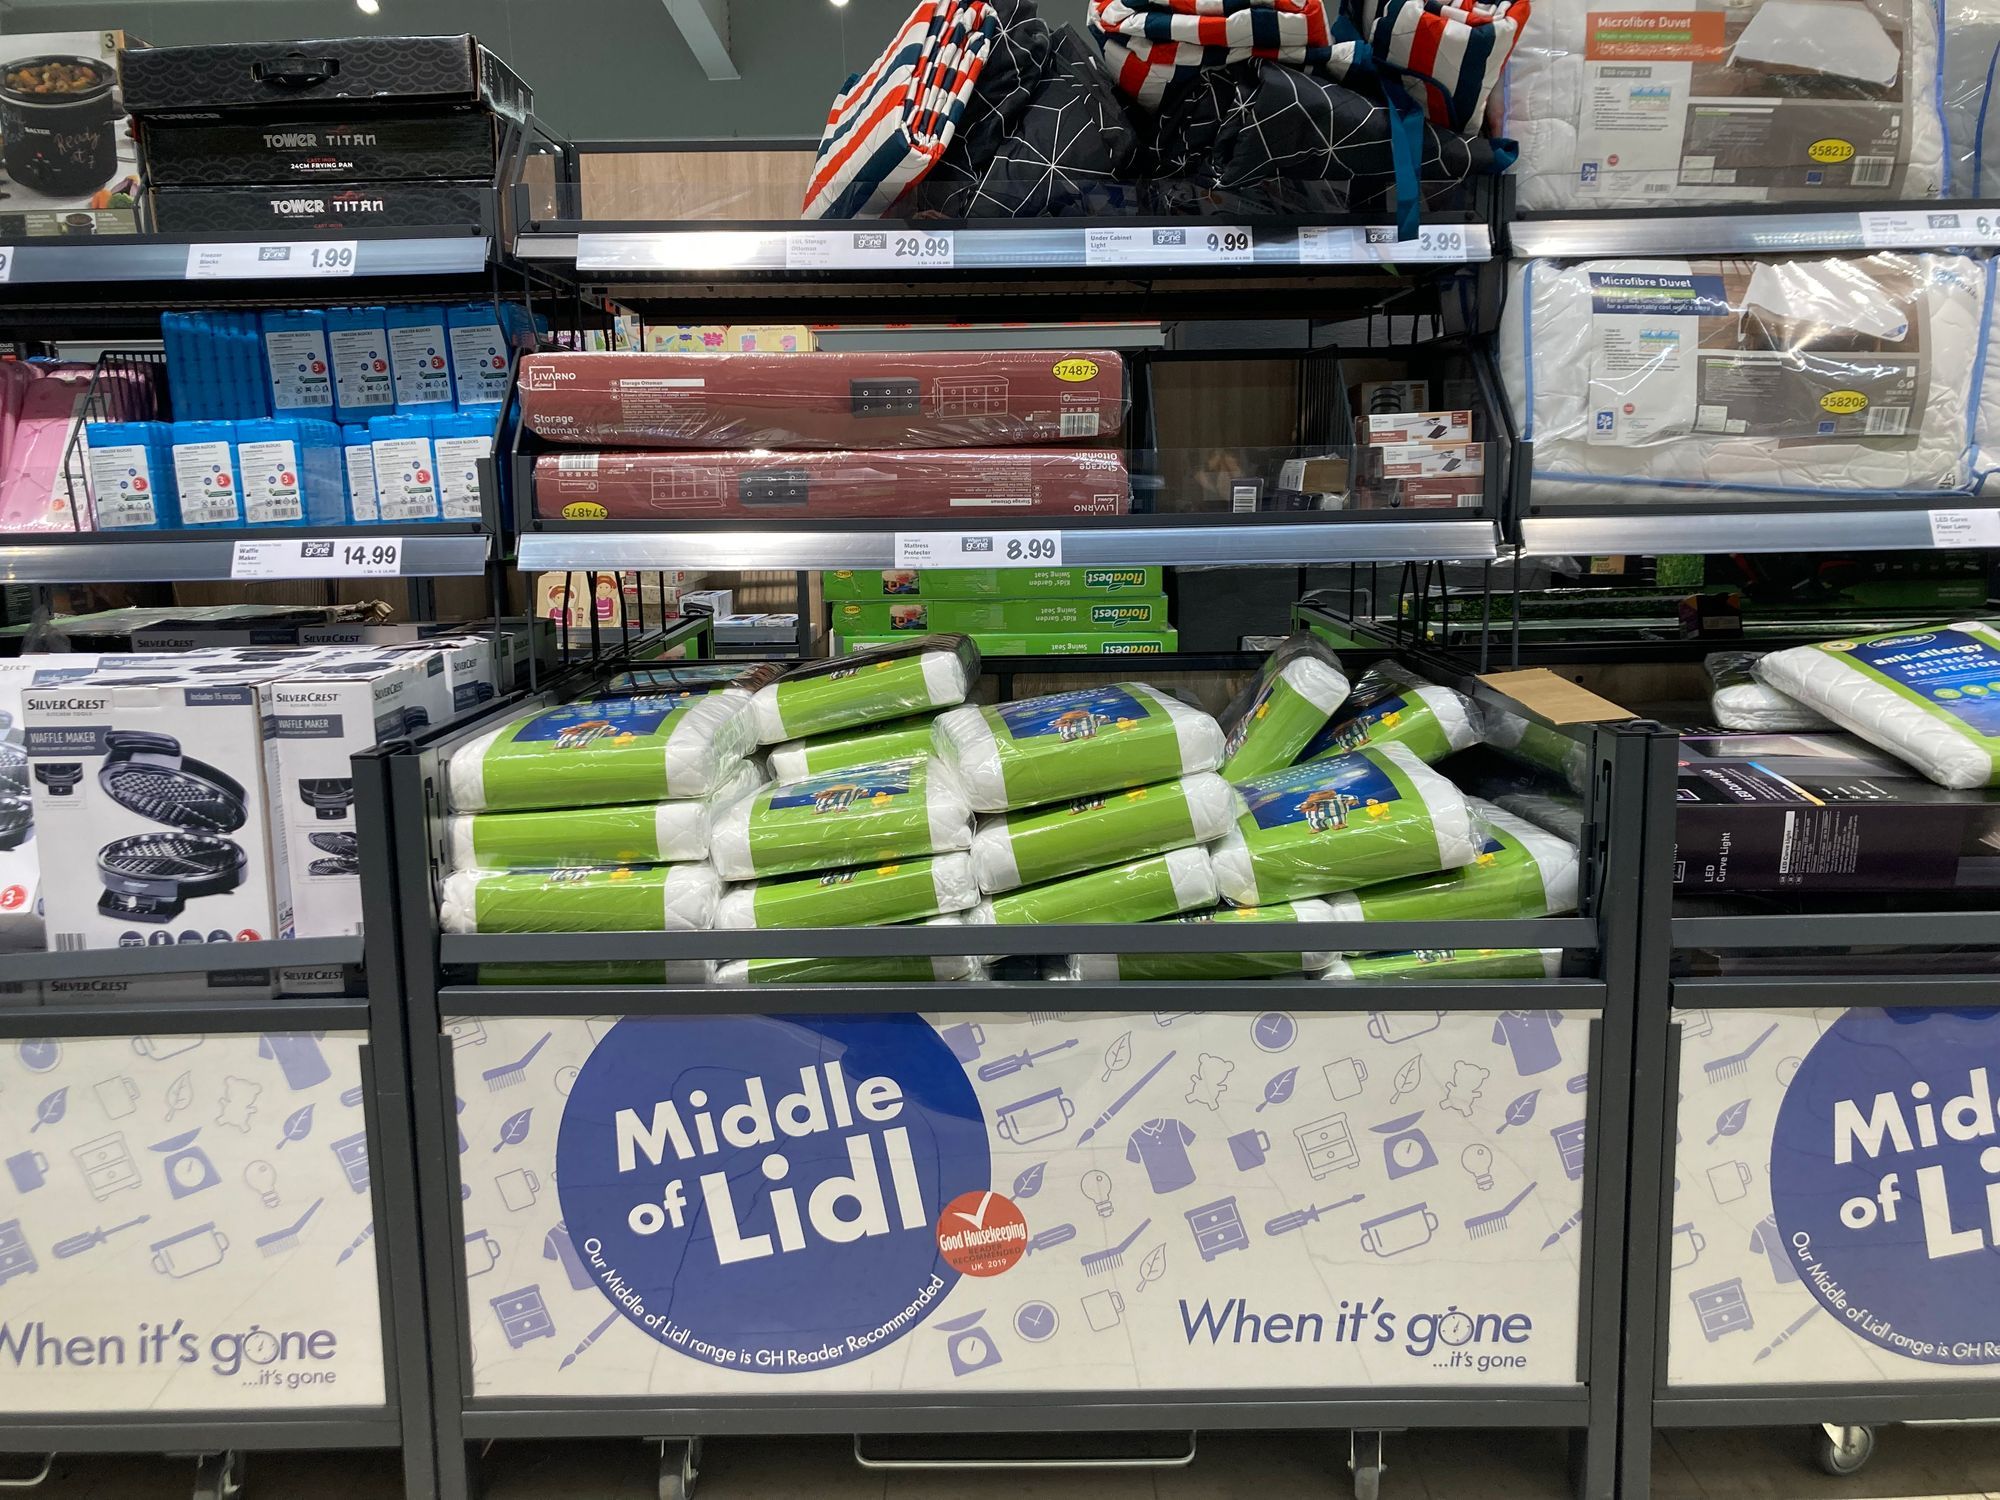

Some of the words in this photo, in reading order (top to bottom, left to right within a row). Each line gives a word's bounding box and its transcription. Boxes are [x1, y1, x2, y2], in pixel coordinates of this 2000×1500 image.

[1598, 16, 1655, 28] Microfibre
[1659, 16, 1691, 28] Duvet
[104, 33, 115, 49] 3
[263, 133, 317, 148] TOWER
[326, 134, 377, 146] TITAN
[1808, 144, 1853, 158] 358213
[271, 199, 325, 214] TOWER
[333, 200, 384, 212] TITAN
[858, 238, 882, 248] gone
[1157, 234, 1181, 244] gone
[1206, 232, 1249, 252] 9.99
[1370, 232, 1393, 242] gone
[1420, 232, 1461, 251] 3.99
[895, 238, 949, 257] 29.99
[311, 247, 352, 268] 1.99
[1600, 276, 1656, 287] Microfibre
[1660, 277, 1692, 288] Duvet
[533, 372, 576, 380] LIVARNO
[1053, 365, 1097, 376] 374875
[1822, 396, 1866, 408] 358208
[533, 414, 574, 424] Storage
[535, 426, 579, 435] Ottoman
[564, 507, 606, 518] 374875
[1073, 504, 1114, 512] LIVARNO
[305, 546, 330, 556] gone
[966, 541, 988, 550] gone
[1006, 538, 1055, 560] 8.99
[344, 545, 396, 565] 14.99
[1087, 571, 1143, 584] florabest
[1093, 607, 1149, 620] florabest
[137, 639, 194, 648] SILVERCREST
[303, 634, 360, 643] SILVERCREST
[1872, 644, 1983, 665] anti-allergy
[1901, 654, 1984, 670] MATTRESS
[1906, 660, 2000, 677] PROTECTOR
[28, 698, 105, 710] SILVERCREST
[276, 692, 338, 702] SILVERCREST
[278, 719, 303, 729] WAFFLE
[304, 718, 329, 728] MAKER
[30, 732, 64, 743] WAFFLE
[65, 731, 96, 743] MAKER
[1719, 832, 1731, 856] Light
[1705, 864, 1715, 882] LED
[1717, 857, 1728, 882] Curve
[52, 980, 128, 992] SILVERCREST
[615, 1061, 904, 1173] Middle
[628, 1179, 687, 1235] of
[699, 1126, 927, 1265] Lidl
[1839, 1173, 1901, 1229] of
[940, 1232, 964, 1251] Good
[963, 1221, 1026, 1247] Housekeeping
[952, 1247, 1021, 1265] RECOMMENDED
[968, 1243, 1002, 1255] READER
[971, 1263, 983, 1271] UK
[988, 1258, 1007, 1268] 2019
[584, 1237, 607, 1269] Our
[601, 1268, 645, 1316] Middle
[644, 1315, 667, 1329] of
[661, 1320, 691, 1345] Lidl
[690, 1339, 737, 1363] range
[740, 1348, 751, 1364] is
[755, 1350, 784, 1366] GH
[788, 1344, 845, 1366] Reader
[845, 1273, 945, 1352] Recommended
[1792, 1231, 1814, 1262] Our
[1806, 1262, 1848, 1310] Middle
[1846, 1304, 1870, 1322] of
[1862, 1312, 1891, 1340] Lidl
[1888, 1329, 1934, 1358] range
[1937, 1340, 1949, 1358] is
[1952, 1341, 1982, 1358] GH
[1178, 1297, 1323, 1346] When
[1335, 1296, 1396, 1343] it's
[1405, 1304, 1532, 1357] gone
[0, 1321, 125, 1367] When
[138, 1318, 200, 1365] it's
[210, 1325, 337, 1376] gone
[1432, 1351, 1473, 1368] ...it's
[1477, 1353, 1527, 1372] gone
[287, 1369, 337, 1389] gone
